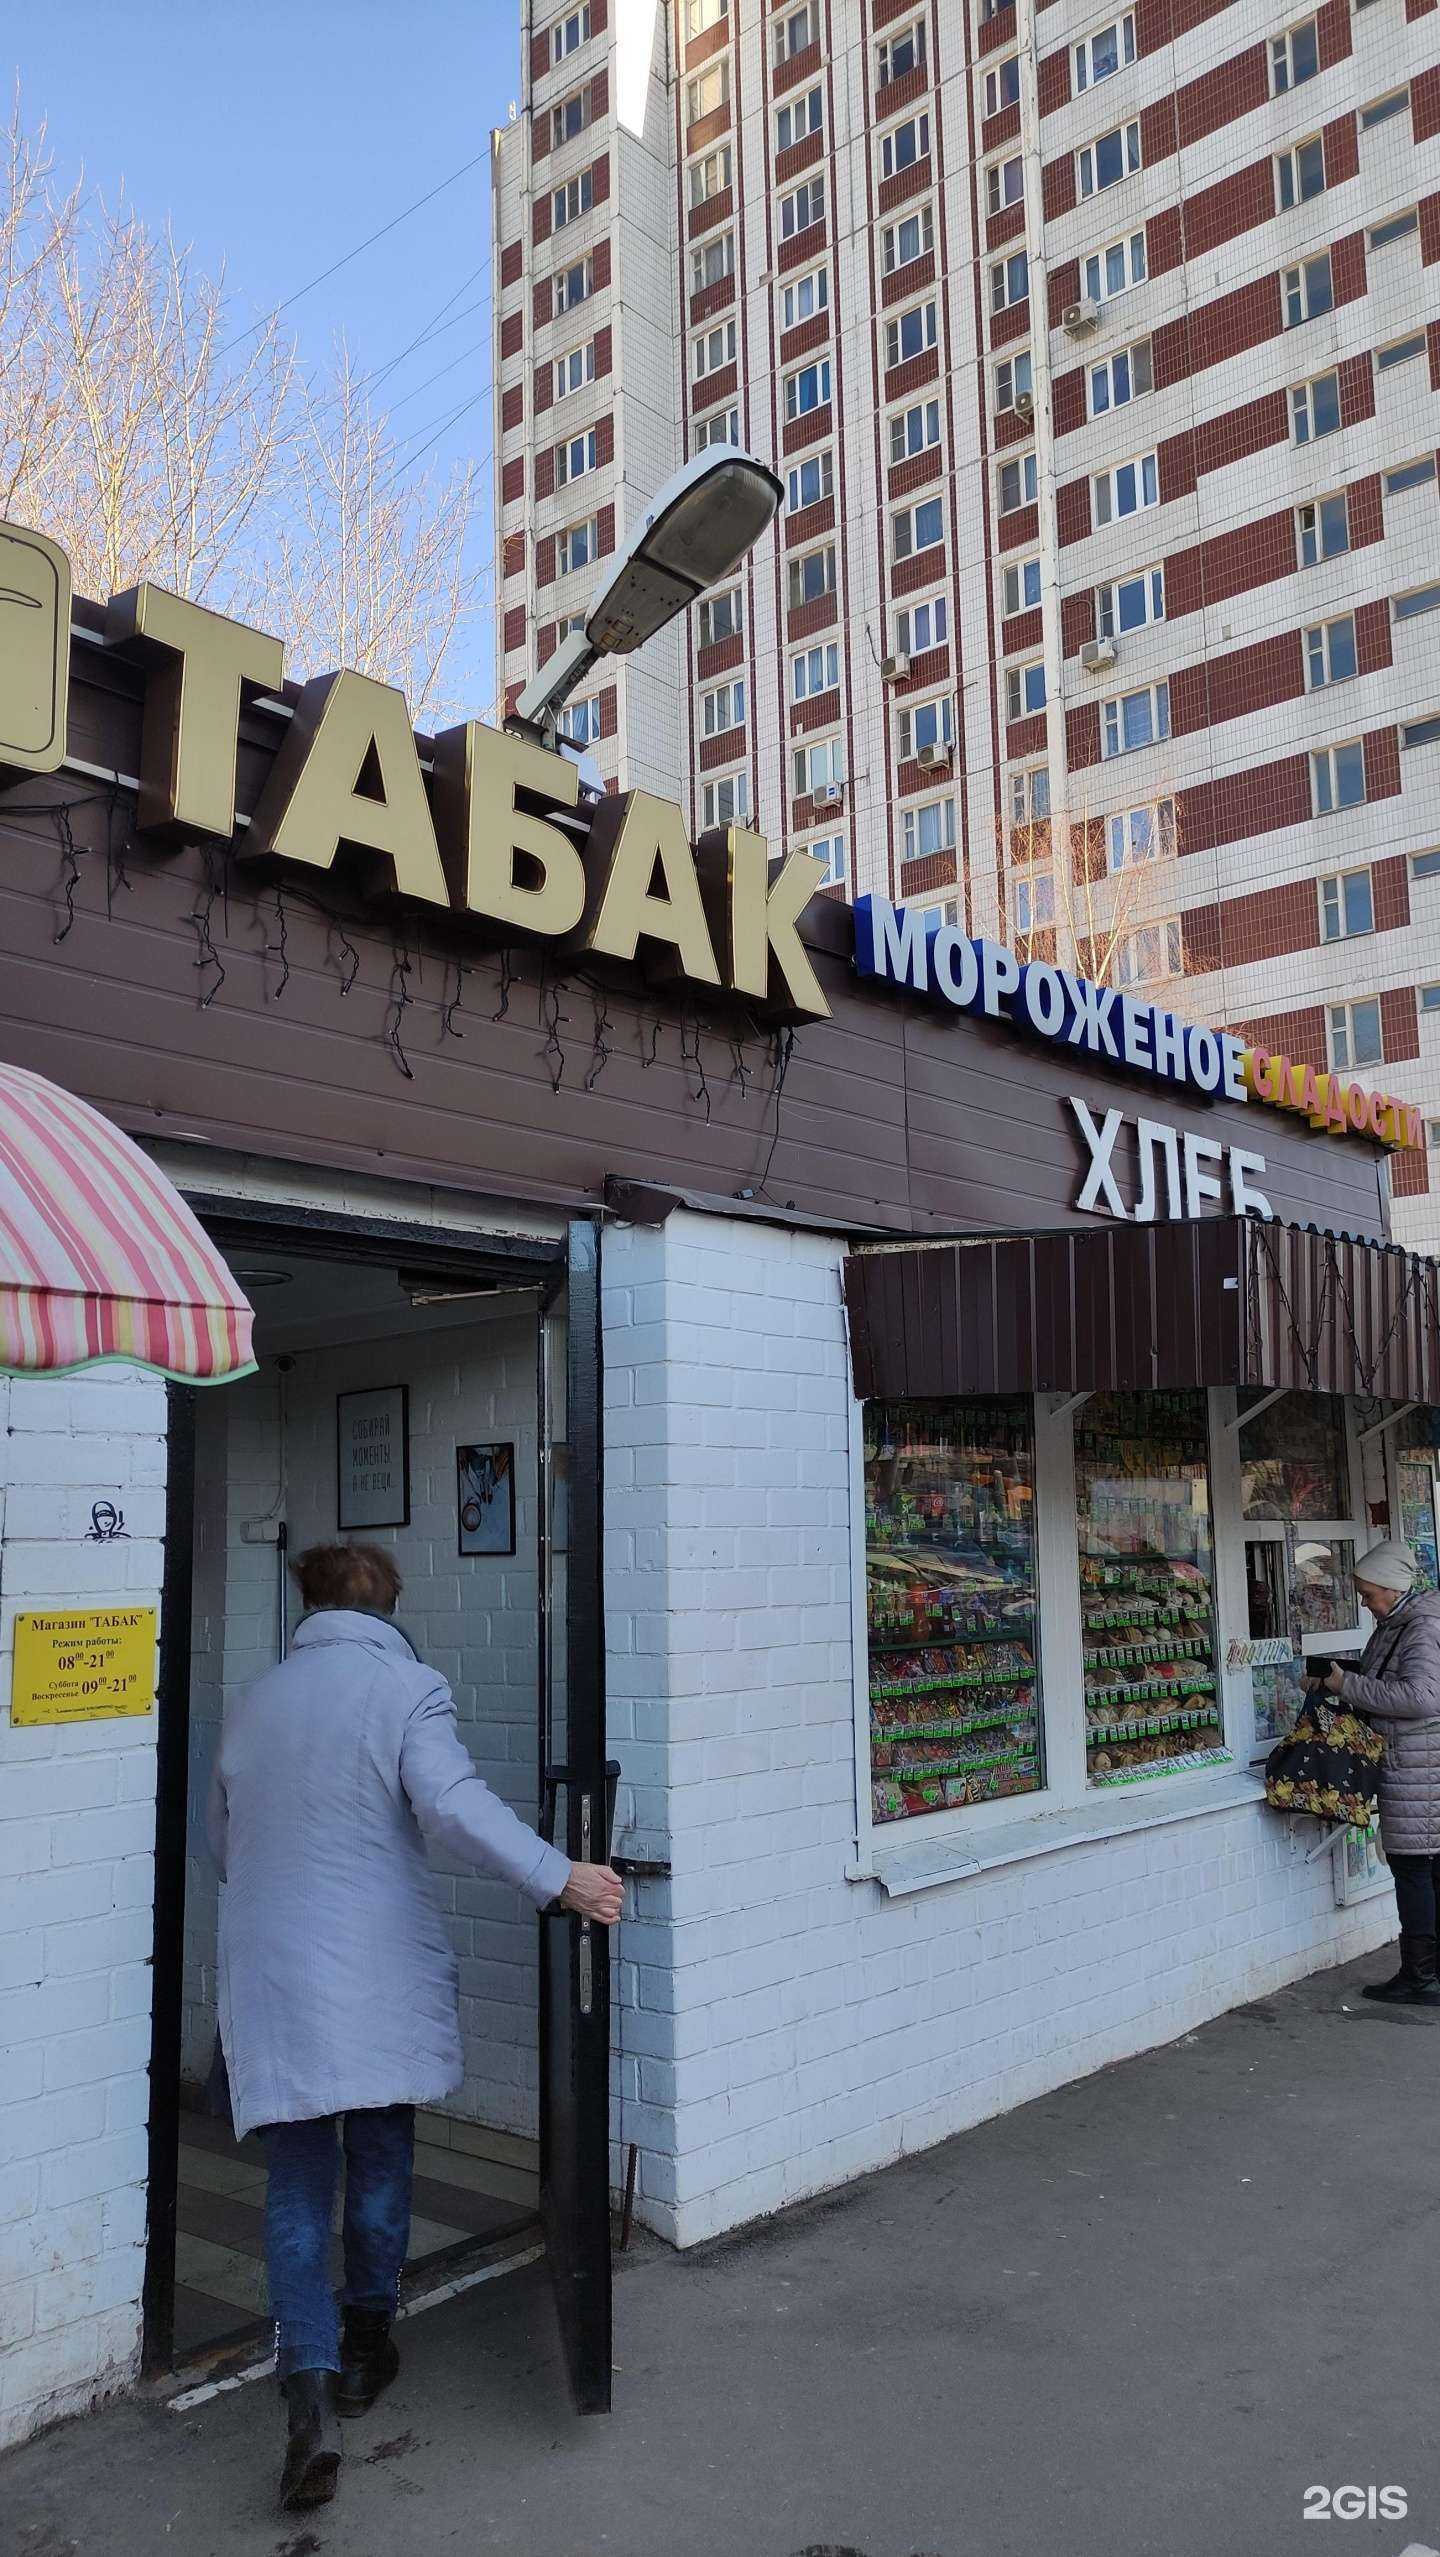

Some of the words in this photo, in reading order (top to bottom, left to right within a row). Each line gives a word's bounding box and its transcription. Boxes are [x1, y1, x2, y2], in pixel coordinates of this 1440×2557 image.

[136, 582, 833, 1021] ТАБАК
[868, 895, 1249, 1103] МОРОЖЕНОЕ
[1251, 1046, 1426, 1150] СЛАДОСТИ
[1068, 1095, 1274, 1223] ХЛЕБ
[31, 1618, 86, 1632] Магазин
[90, 1614, 143, 1629] "ТАБАК"
[52, 1637, 84, 1649] Режим
[85, 1636, 122, 1648] работы:
[31, 1689, 79, 1702] Воскресенье
[48, 1680, 79, 1690] Суббота
